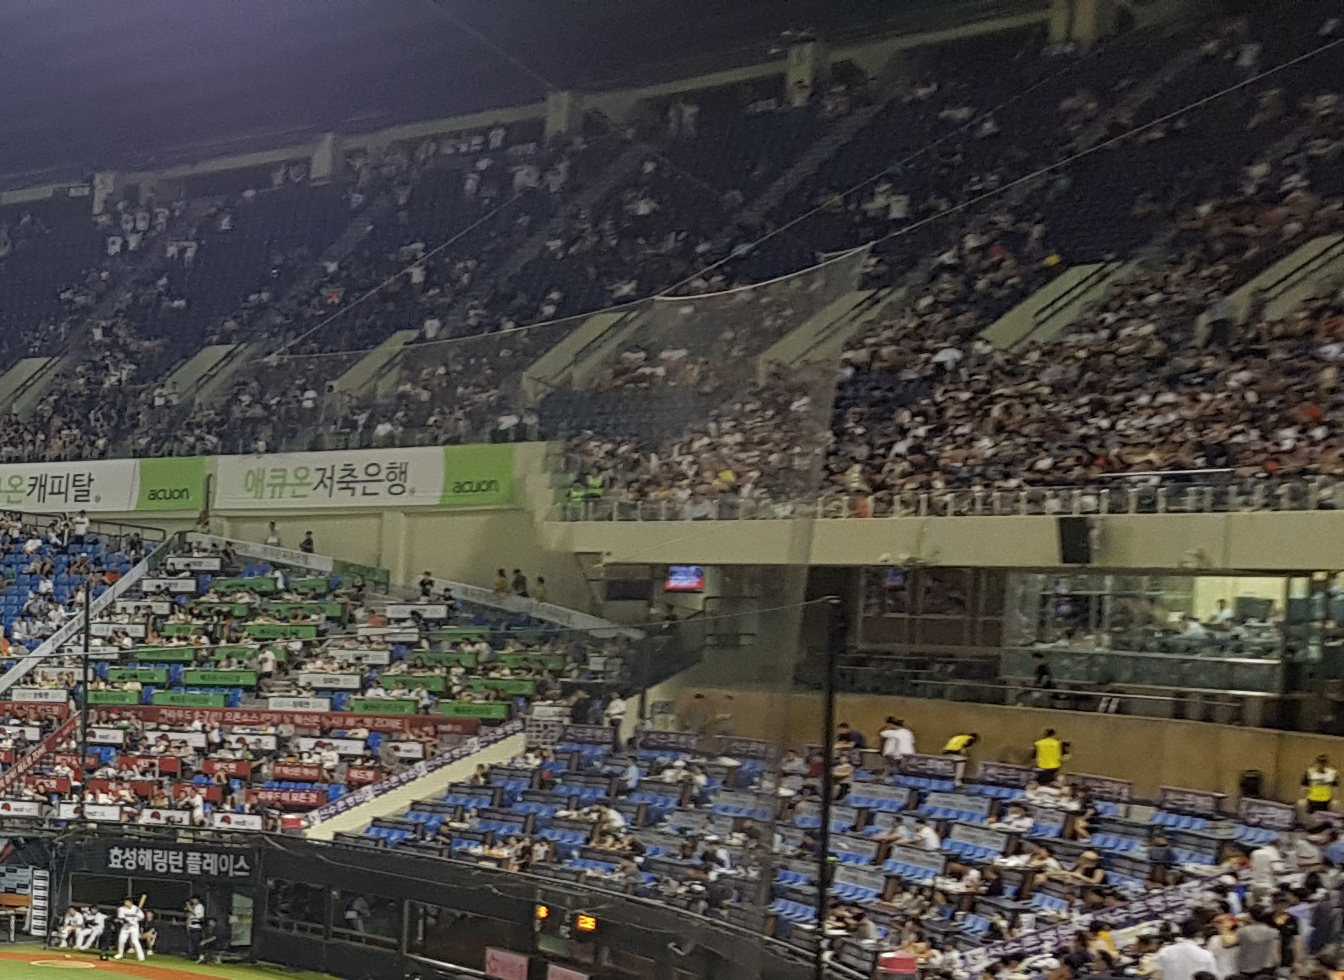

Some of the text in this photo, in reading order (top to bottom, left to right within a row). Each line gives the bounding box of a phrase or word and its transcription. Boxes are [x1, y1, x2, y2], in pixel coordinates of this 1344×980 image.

[147, 487, 190, 501] acuon
[452, 479, 498, 494] acuon
[109, 846, 251, 877] 효성해링턴 플레이스
